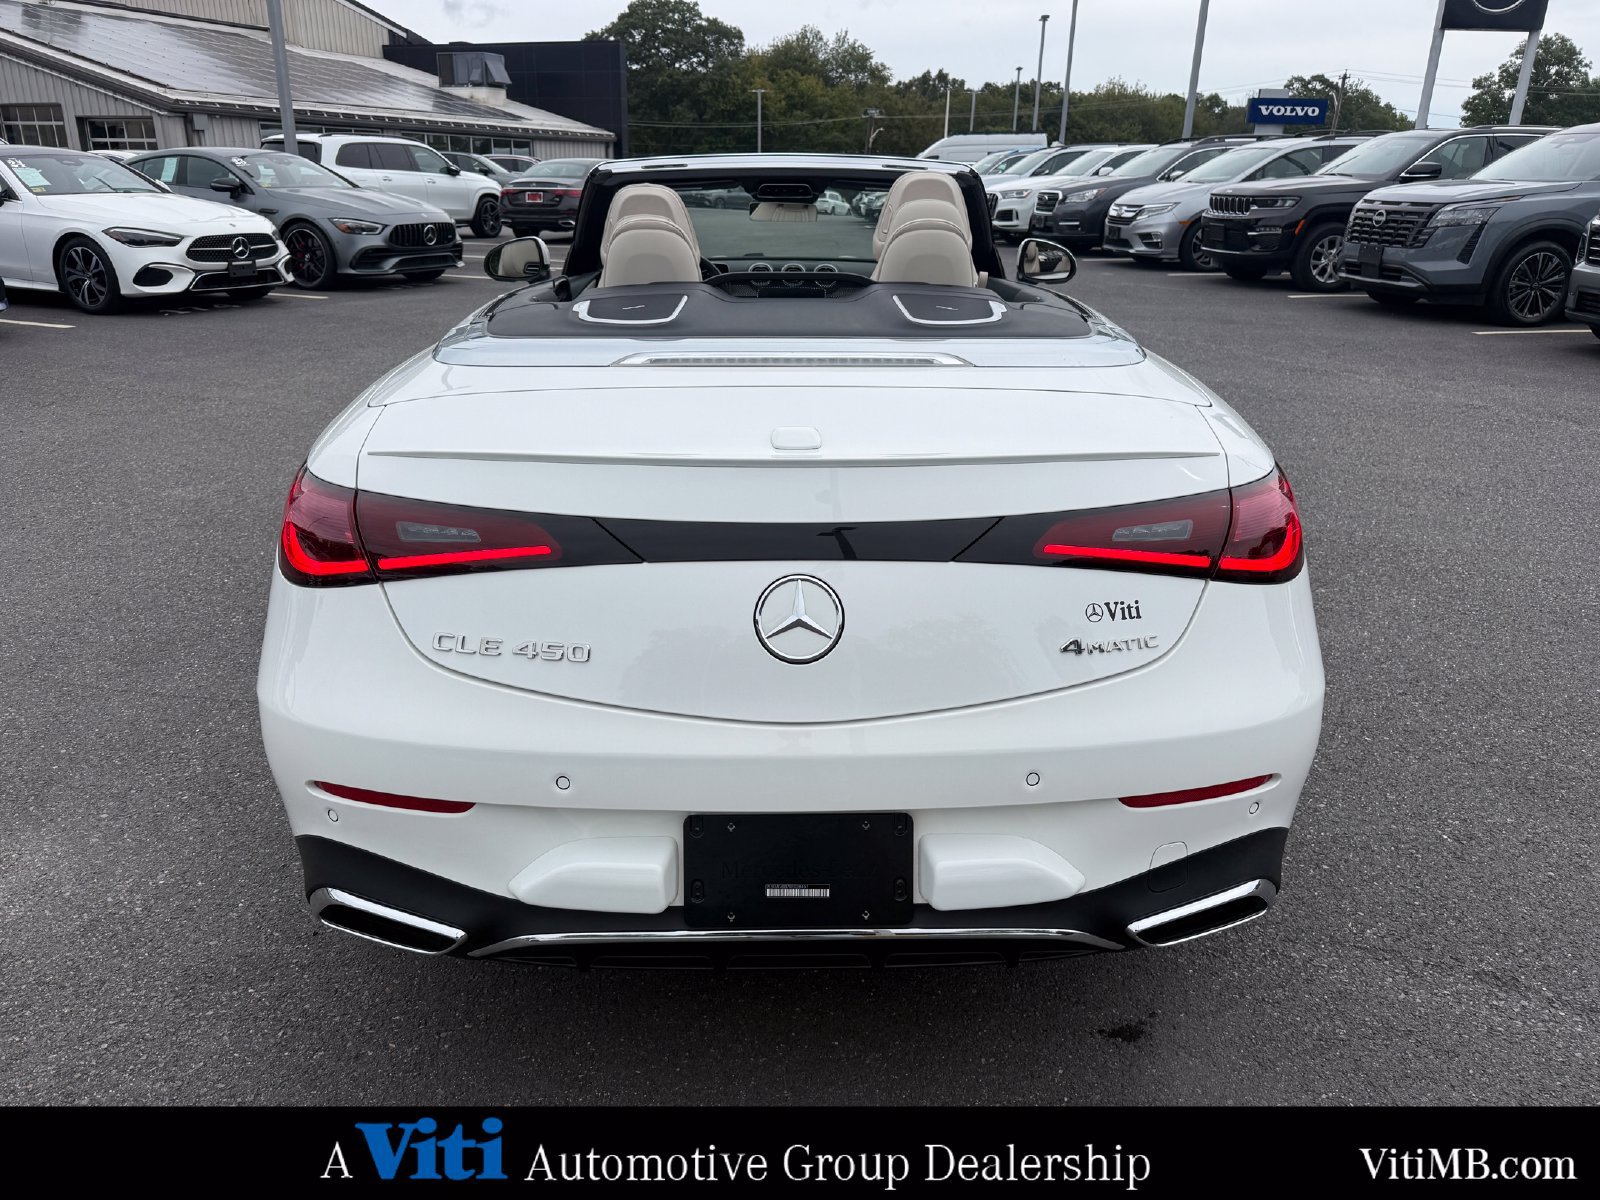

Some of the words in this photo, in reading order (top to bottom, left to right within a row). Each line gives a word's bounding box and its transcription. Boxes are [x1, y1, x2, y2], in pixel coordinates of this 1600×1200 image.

[1258, 105, 1320, 117] VOLVO
[1103, 599, 1142, 621] Viti
[432, 631, 503, 656] CLE
[512, 639, 592, 663] 450
[1059, 634, 1160, 656] 4MATIC
